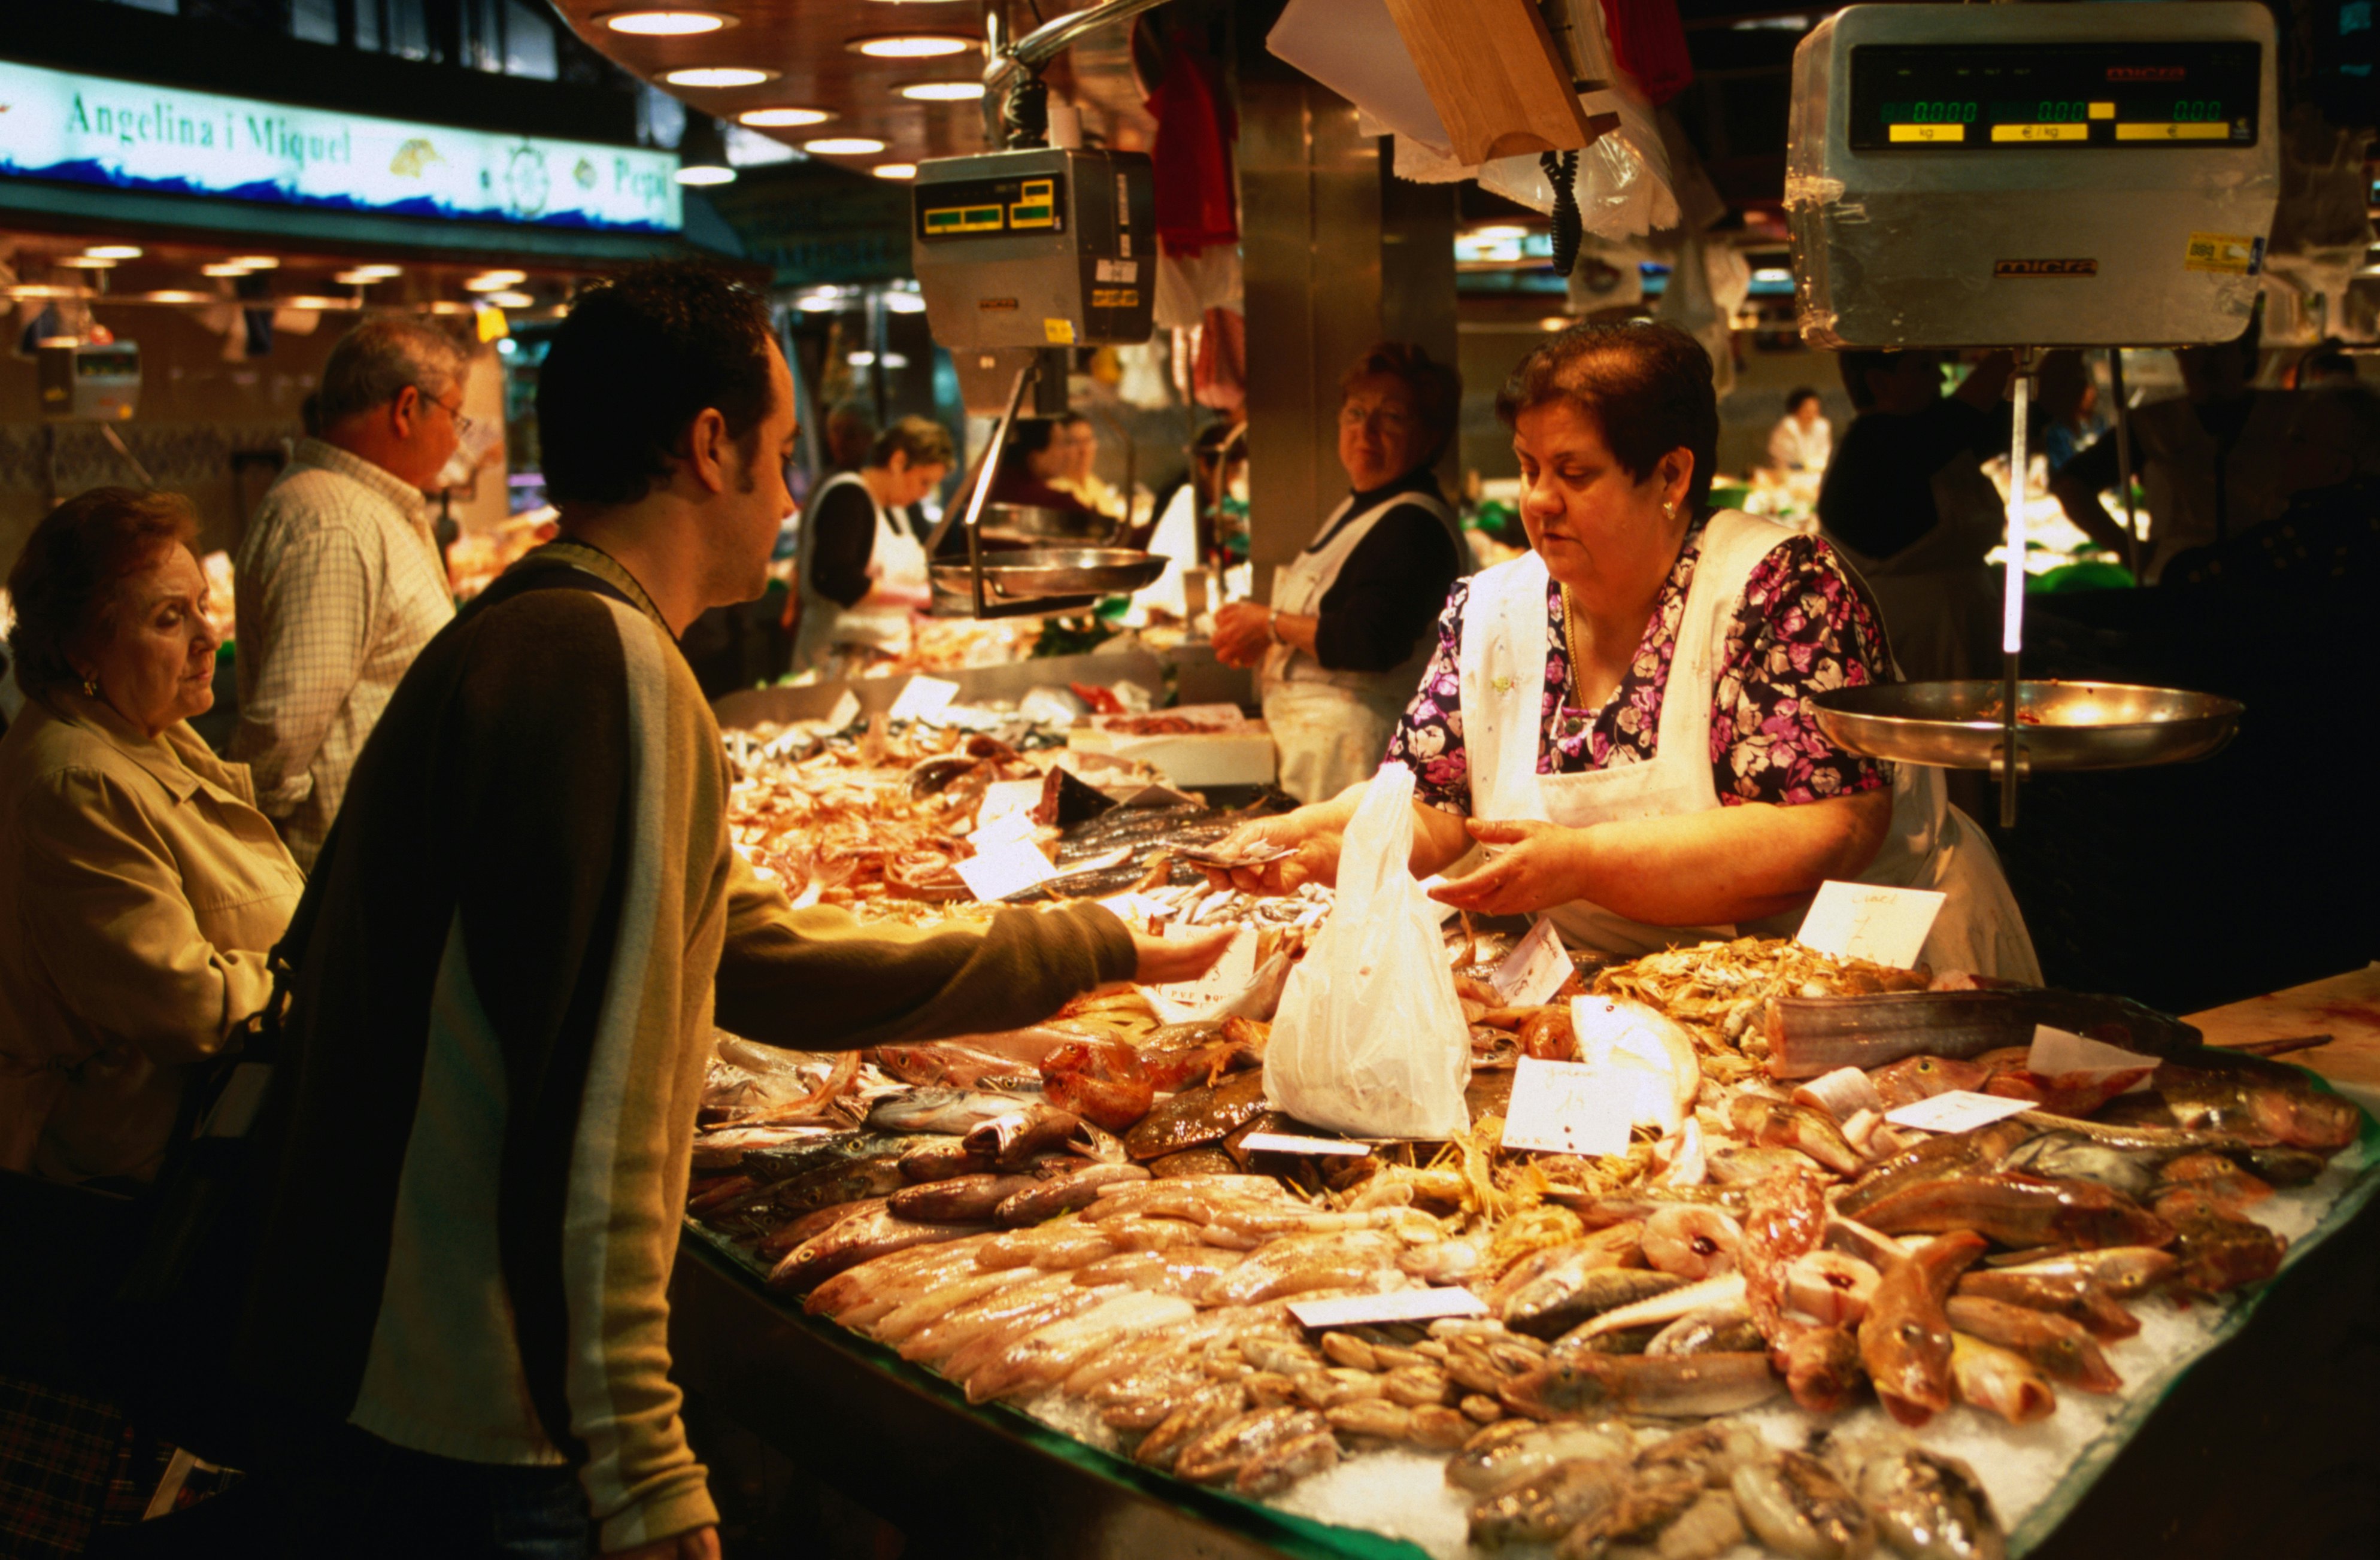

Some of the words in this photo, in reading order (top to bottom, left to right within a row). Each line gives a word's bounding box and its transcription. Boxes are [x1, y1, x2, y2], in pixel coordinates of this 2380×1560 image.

[2107, 67, 2185, 81] micra
[66, 92, 214, 147] Angelina
[225, 111, 235, 150] i
[247, 116, 352, 171] Miquel
[1919, 126, 1934, 139] kg
[1995, 260, 2098, 277] micra
